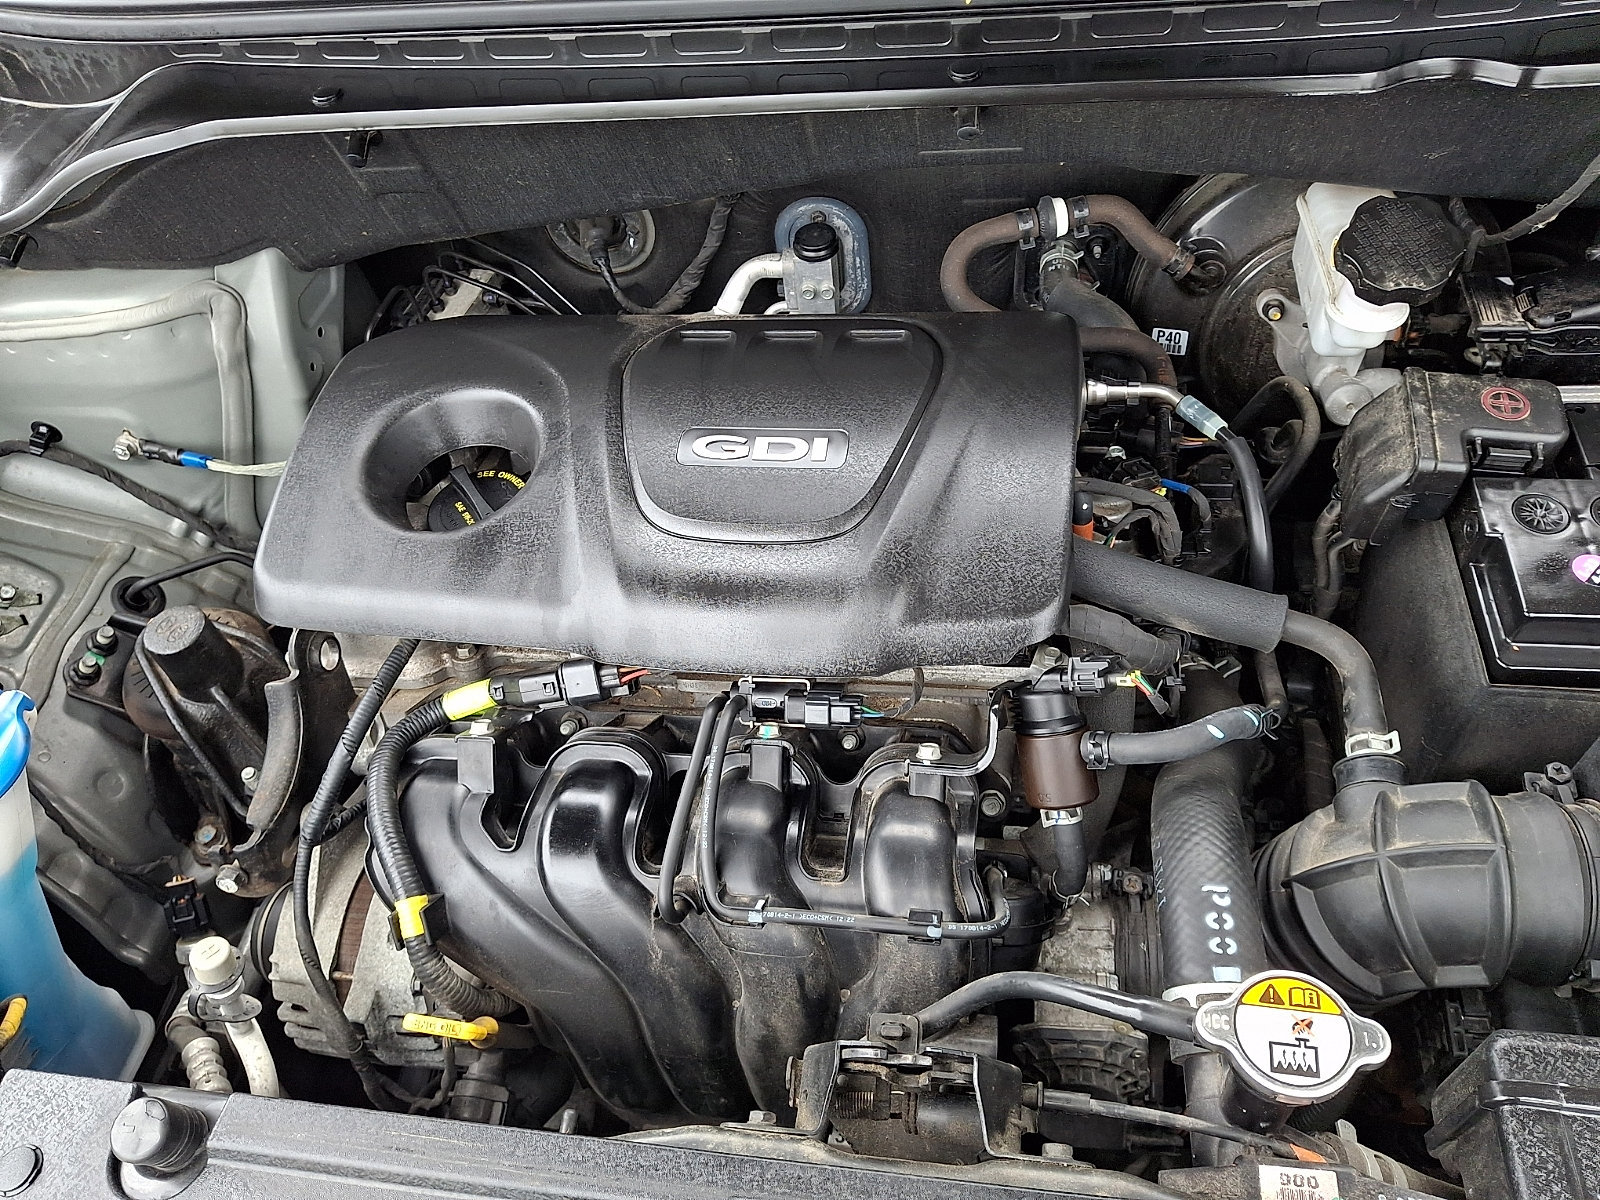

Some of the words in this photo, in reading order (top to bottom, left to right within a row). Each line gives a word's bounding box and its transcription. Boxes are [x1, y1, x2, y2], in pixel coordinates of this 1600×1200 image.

[1157, 330, 1181, 344] P40
[692, 434, 829, 462] GDI
[477, 470, 496, 478] SEE
[497, 471, 526, 489] OWNER
[759, 911, 795, 919] 70814-2-1
